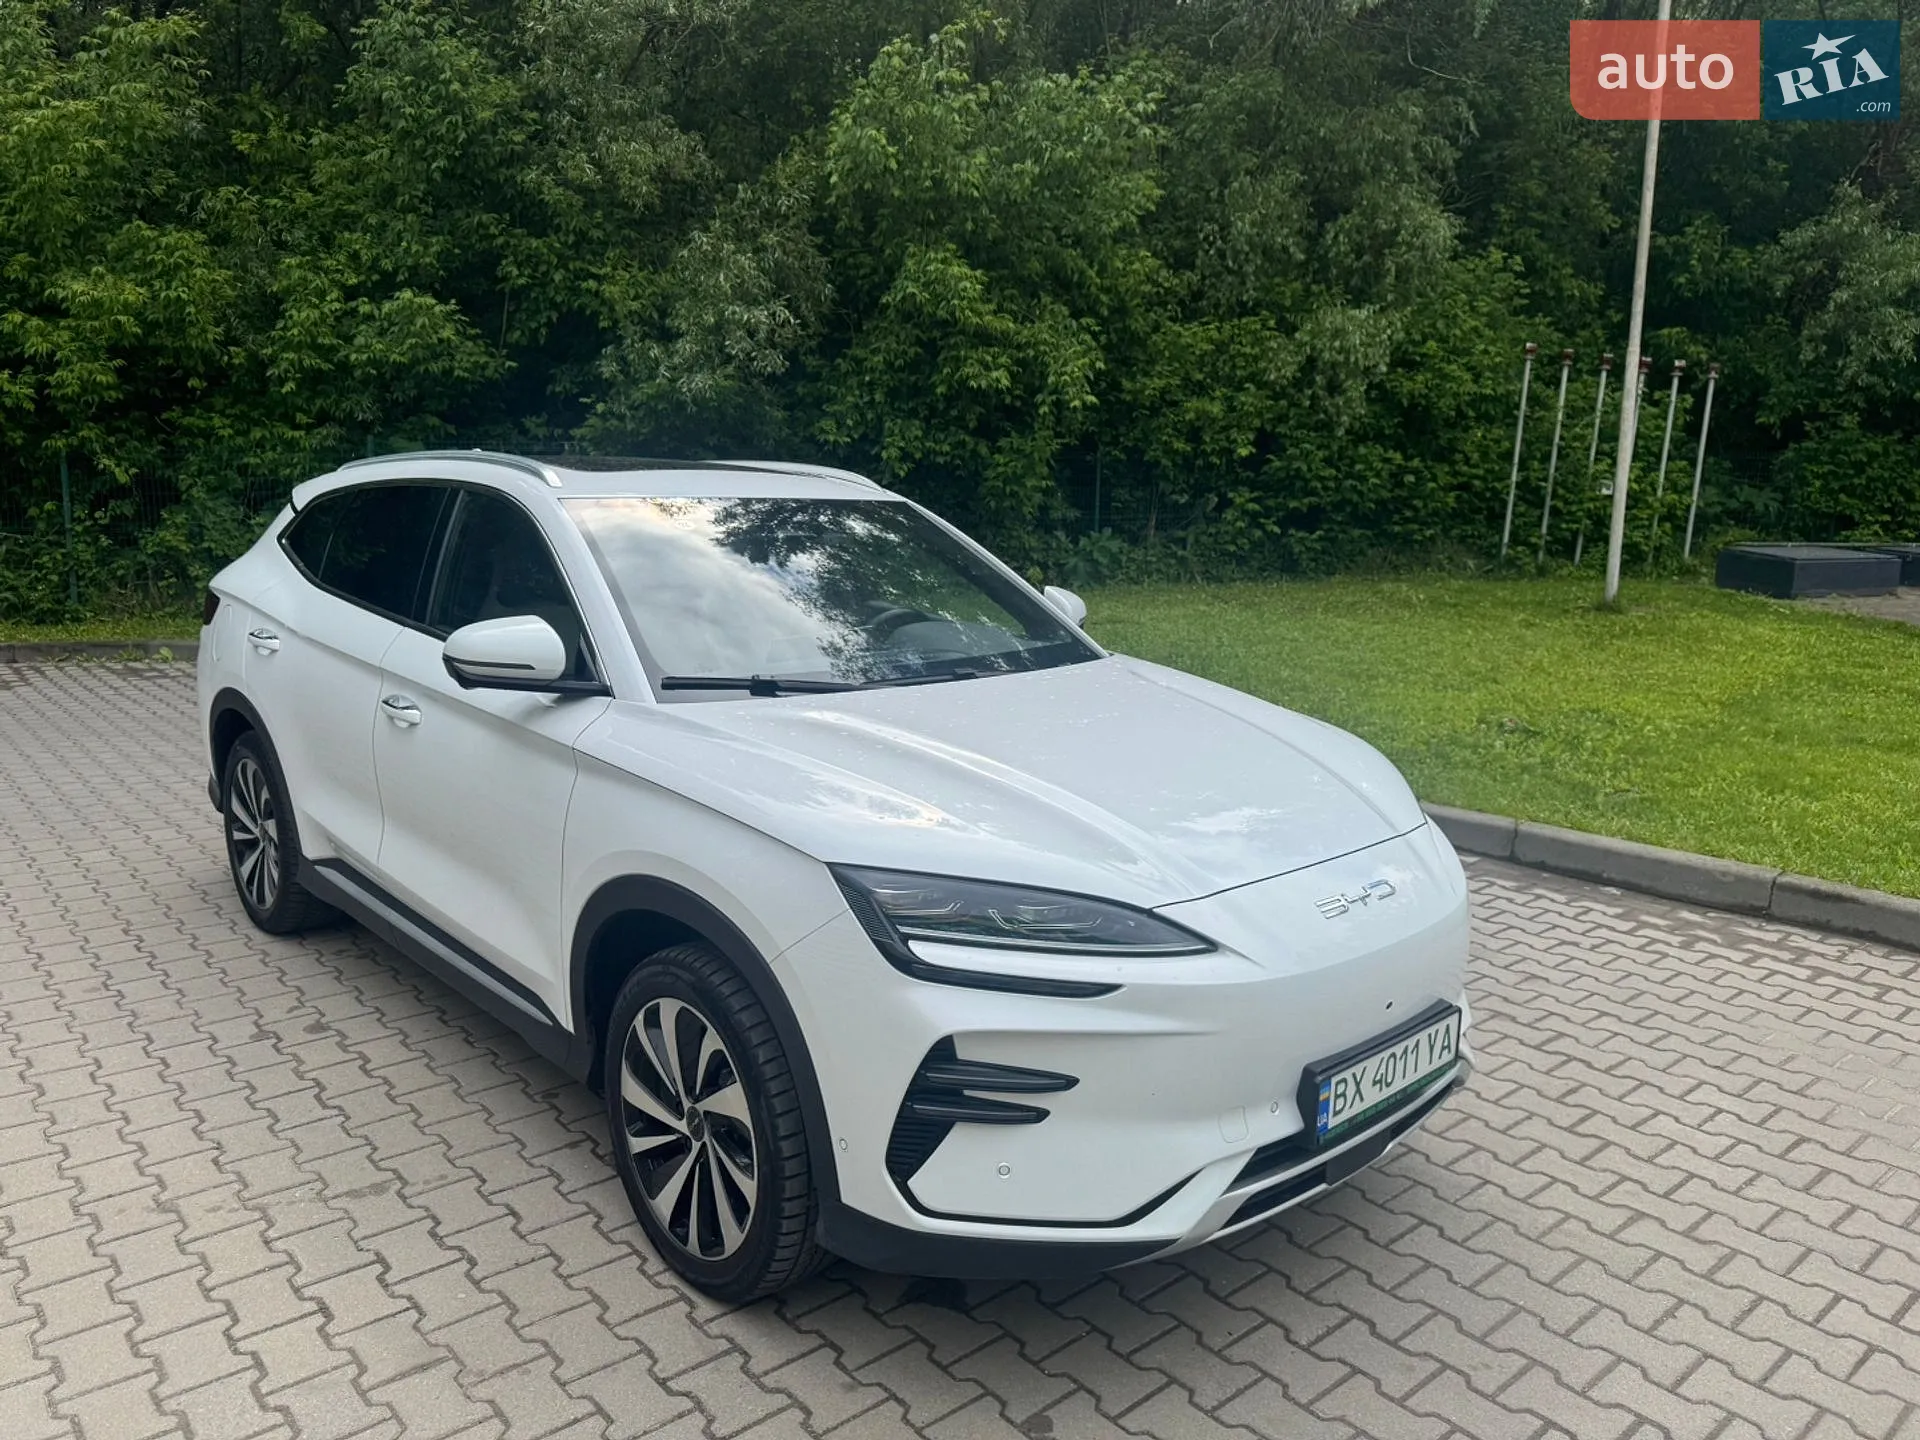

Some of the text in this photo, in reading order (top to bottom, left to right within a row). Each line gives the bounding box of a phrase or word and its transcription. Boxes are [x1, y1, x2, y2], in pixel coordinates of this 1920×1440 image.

[1314, 879, 1397, 920] BYD
[1332, 1066, 1367, 1117] BX
[1371, 1038, 1420, 1092] 4011
[1427, 1023, 1452, 1065] YA
